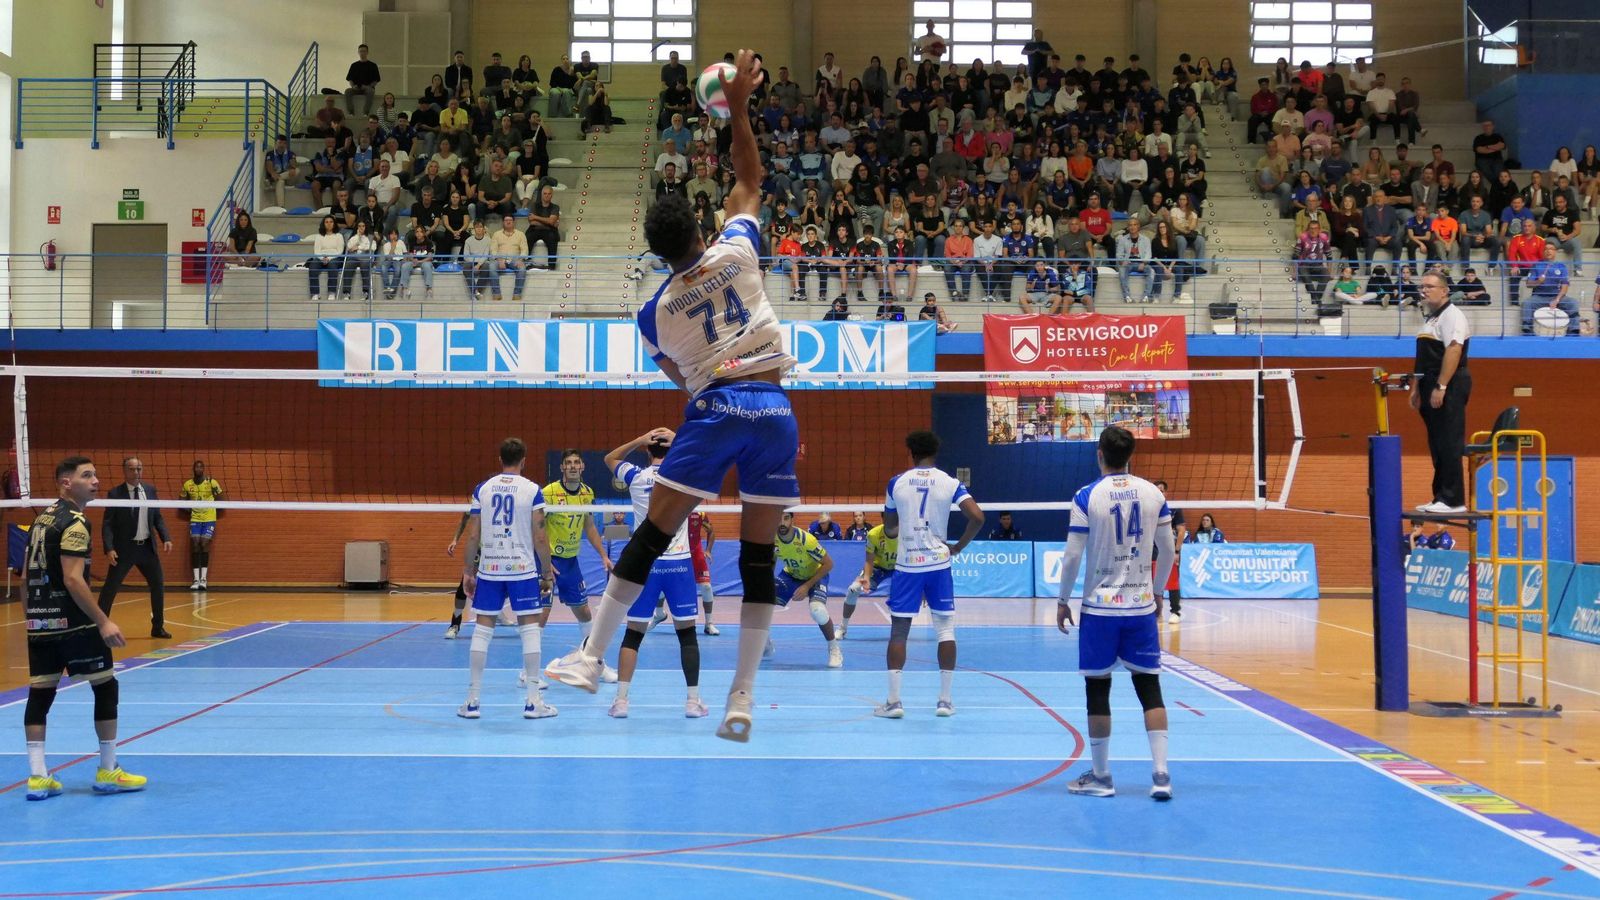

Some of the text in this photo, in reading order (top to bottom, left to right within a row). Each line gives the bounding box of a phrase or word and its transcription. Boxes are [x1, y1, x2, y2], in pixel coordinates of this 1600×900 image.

[125, 209, 137, 219] 10
[664, 262, 742, 316] VIDONI GELARDI
[685, 284, 751, 345] 74
[1046, 323, 1159, 342] SERVIGROUP
[344, 321, 909, 385] BENIDRM
[1046, 346, 1107, 358] HOTELES
[1127, 344, 1137, 364] el
[1141, 340, 1175, 364] deporte
[916, 487, 929, 519] 7
[1109, 489, 1139, 501] RAMIREZ
[491, 493, 515, 526] 29
[567, 514, 583, 529] 77
[1109, 500, 1144, 546] 14
[951, 552, 1028, 565] RVIGROUP
[1212, 548, 1298, 556] Comunitat Valenciana
[951, 569, 979, 577] TELES
[1212, 557, 1298, 570] COMUNITAT
[1220, 570, 1310, 583] DE L'ESPORT
[1420, 564, 1452, 587] IMED
